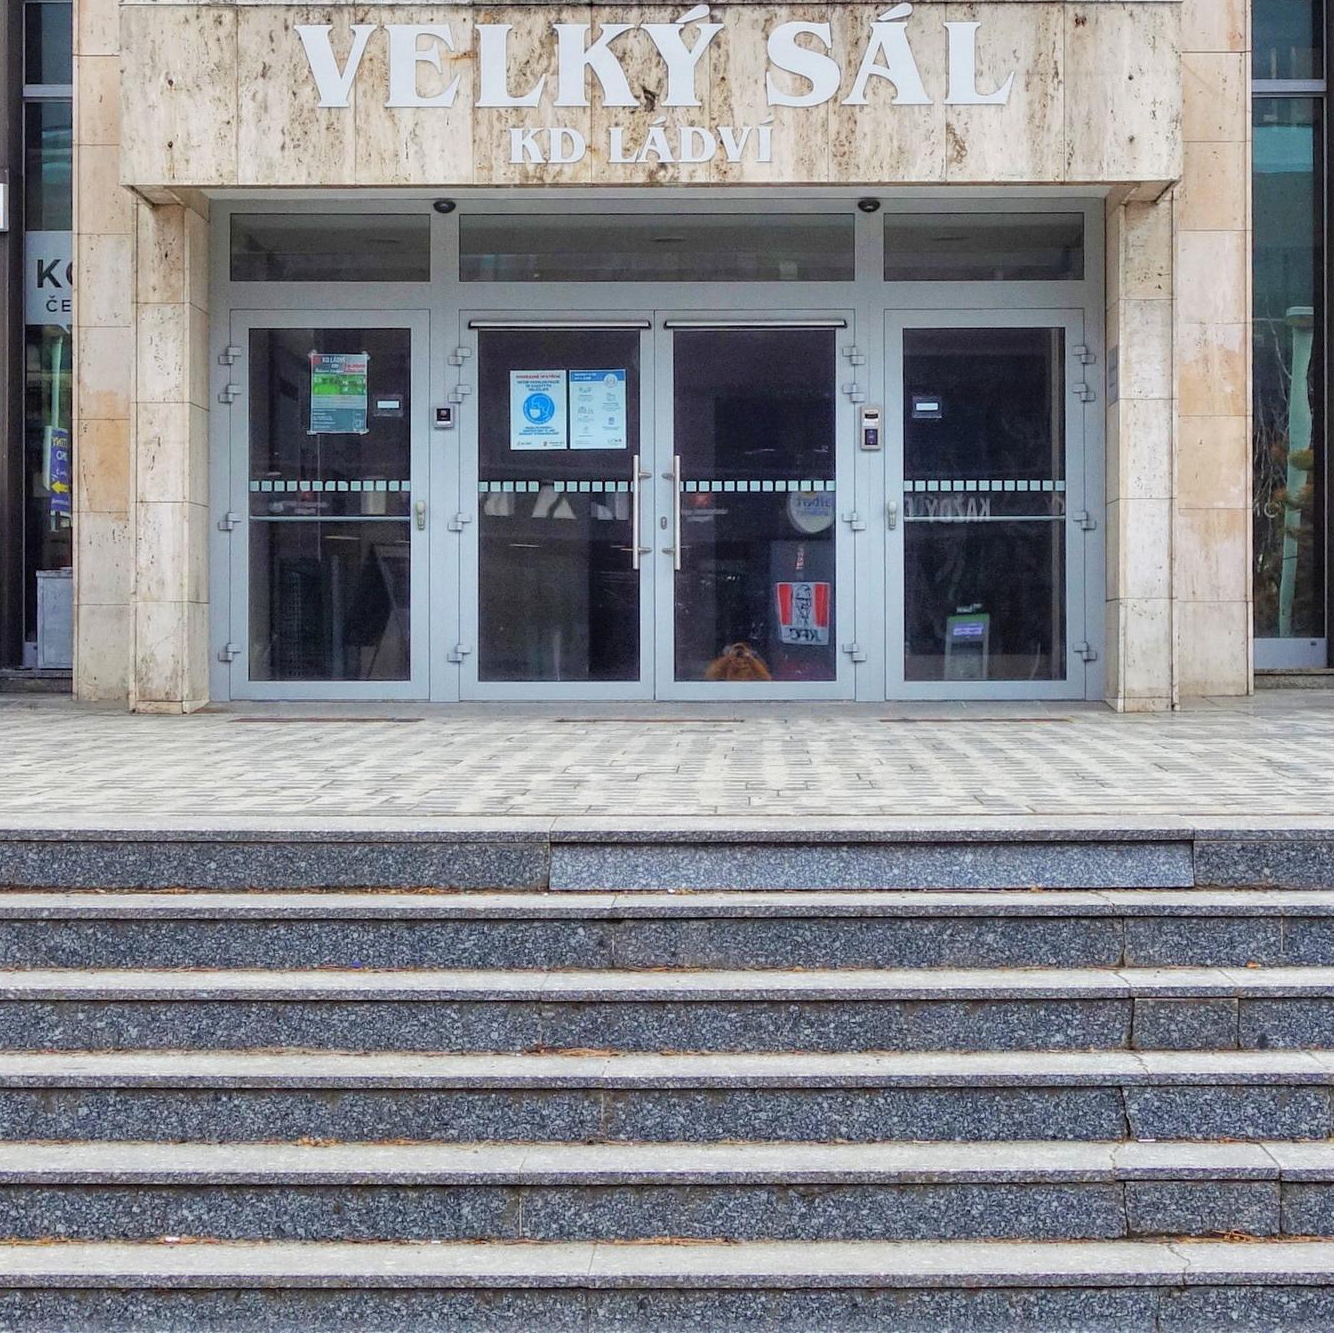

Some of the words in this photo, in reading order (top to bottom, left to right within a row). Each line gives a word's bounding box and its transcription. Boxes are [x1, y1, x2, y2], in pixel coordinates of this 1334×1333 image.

[293, 4, 723, 108] VELKÝ
[766, 2, 1015, 106] SÁL
[508, 127, 586, 163] KD
[608, 117, 774, 163] LÁDVÍ
